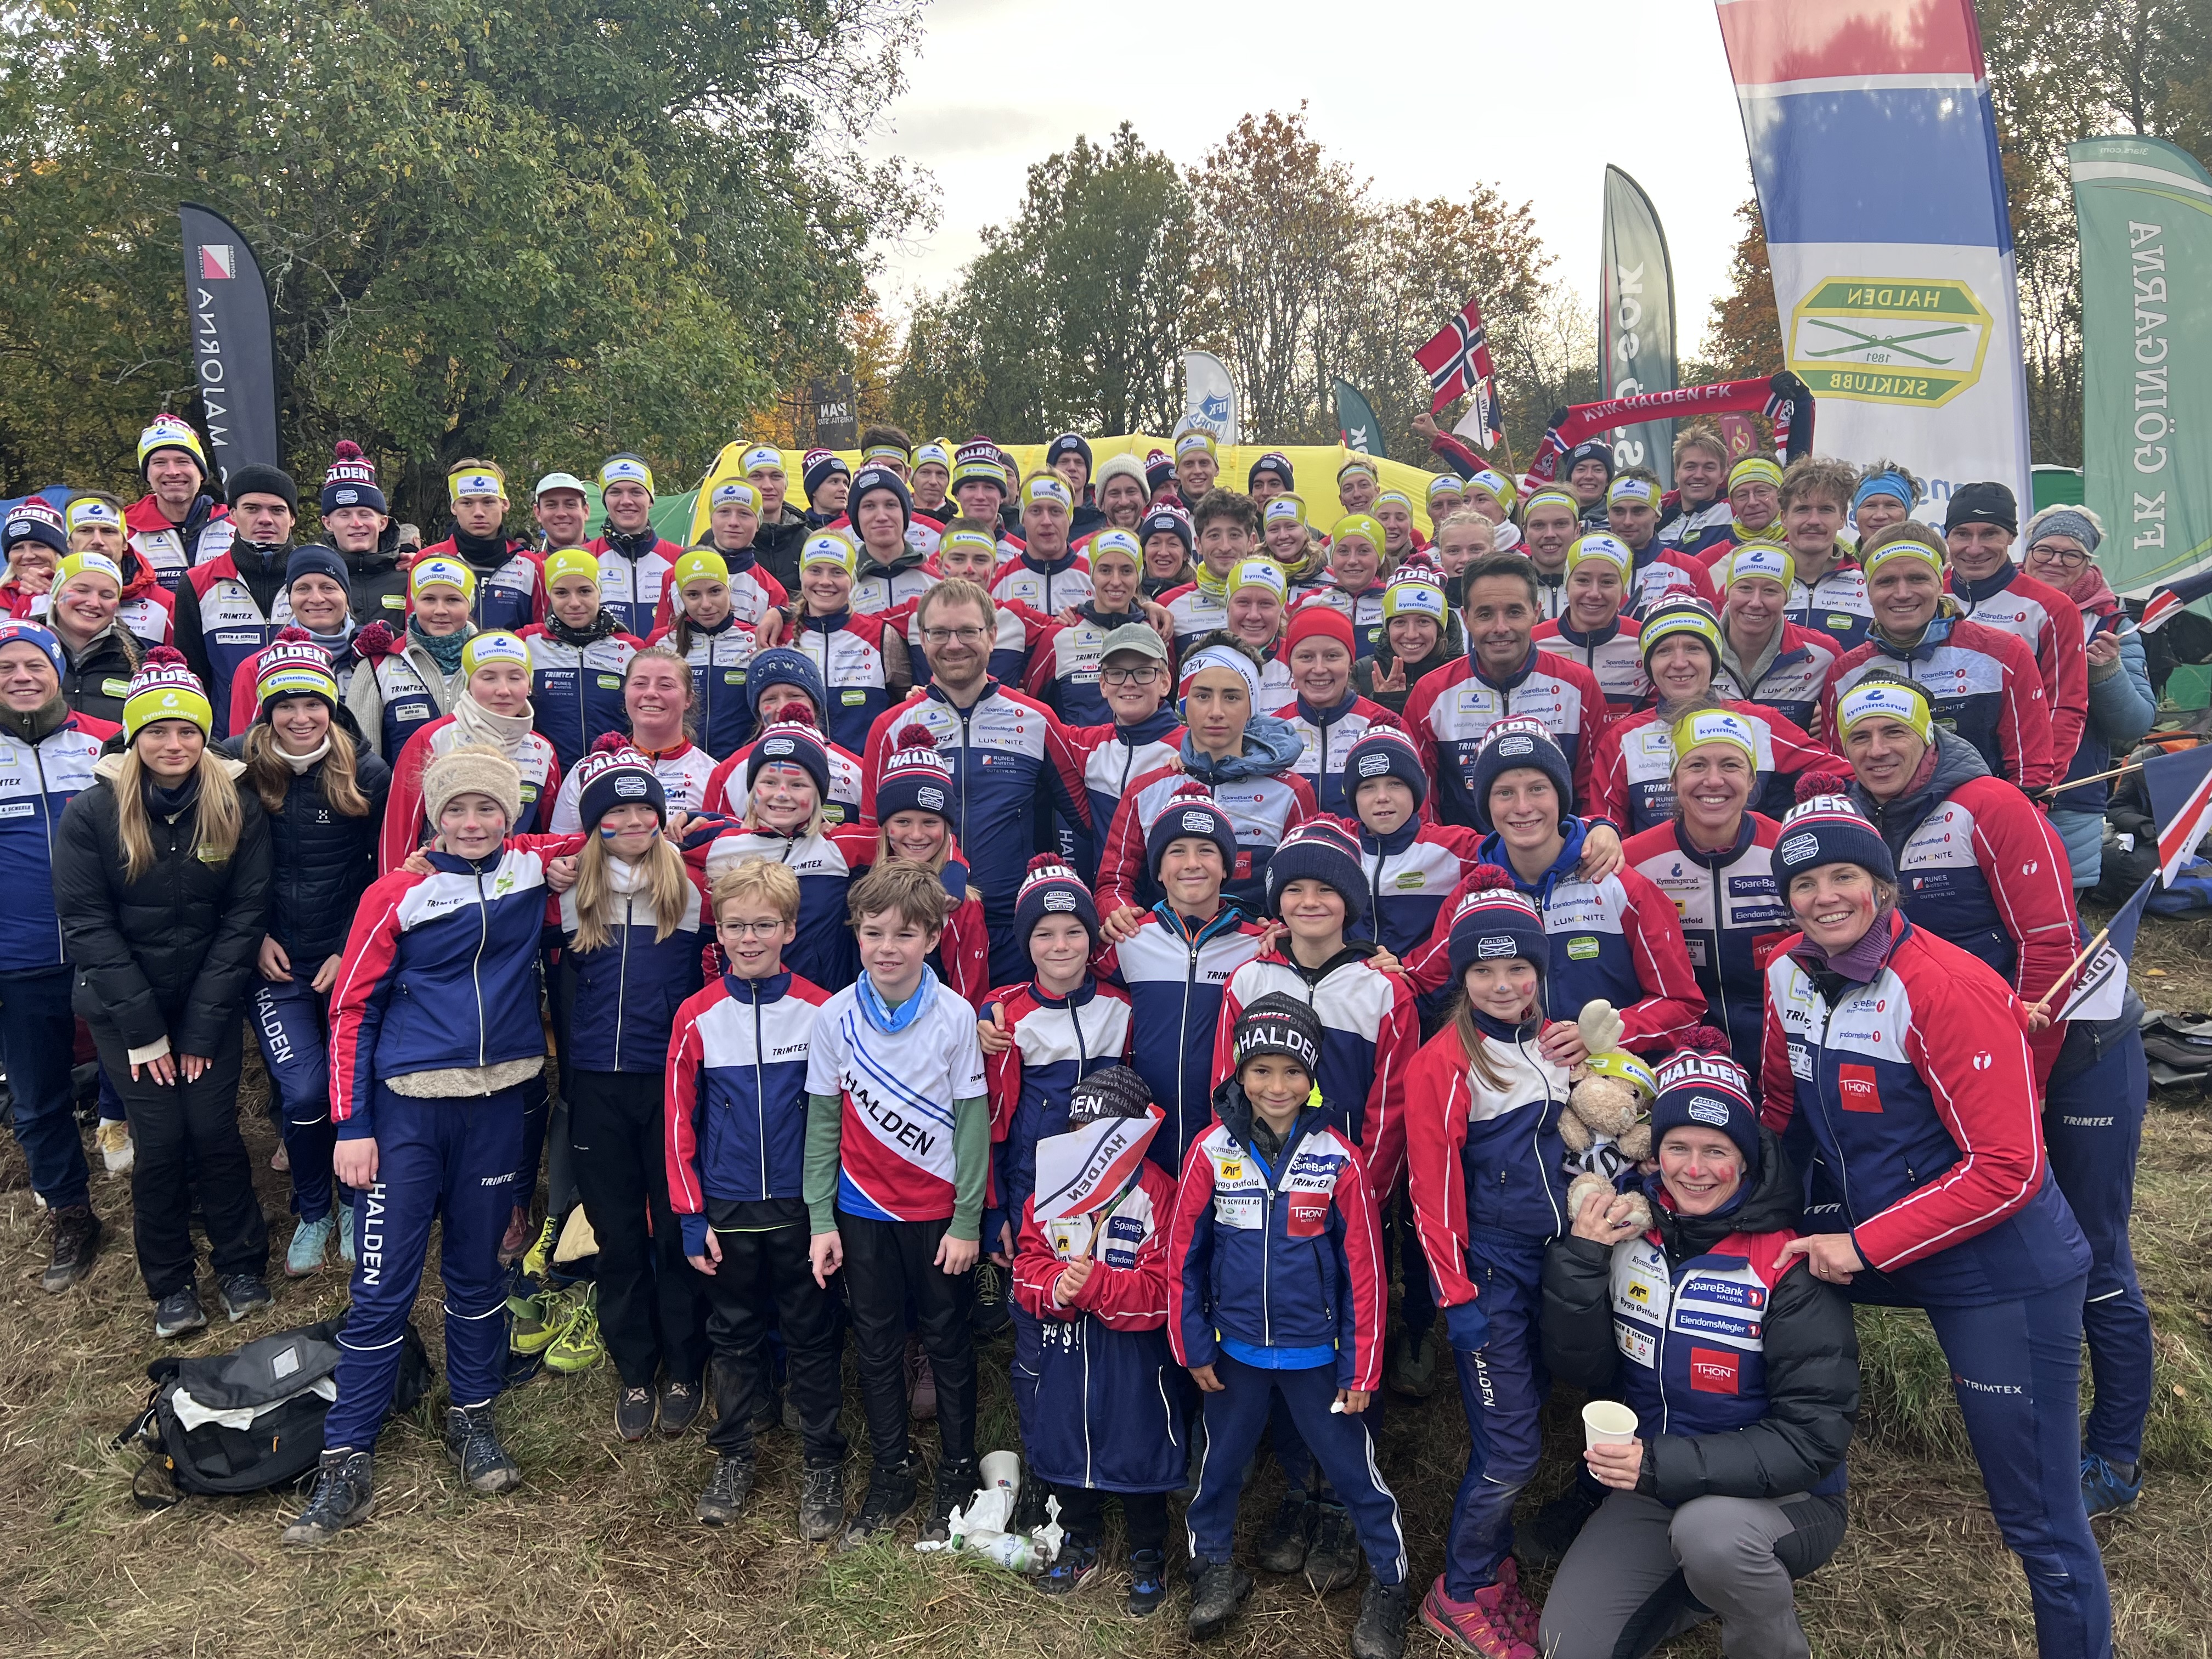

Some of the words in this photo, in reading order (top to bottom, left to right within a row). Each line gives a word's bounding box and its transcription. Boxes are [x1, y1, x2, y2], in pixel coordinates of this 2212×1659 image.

[1582, 400, 1623, 422] KVIK
[1624, 388, 1700, 409] HALDEN
[1705, 385, 1731, 399] FK
[1584, 547, 1624, 563] kynningsrud
[1882, 544, 1931, 556] kynningsrud
[1735, 563, 1780, 574] kynningsrud
[1399, 602, 1440, 612] kynningsrud
[1977, 610, 2013, 619] SpareBank
[1650, 619, 1702, 635] kynningsrud
[477, 648, 524, 658] kynningsrud
[278, 675, 324, 685] kynningsrud
[391, 685, 423, 693] TRIMTEX
[142, 709, 198, 721] kynningsrud
[1847, 702, 1907, 718] kynningsrud
[978, 737, 1024, 746] LUMONITE
[1700, 727, 1751, 746] kynningsrud
[1785, 835, 1808, 847] HALDEN
[1788, 851, 1814, 862] SKIKLUBB
[1908, 851, 1953, 864] LUMONITE
[1734, 879, 1775, 889] SpareBa
[1553, 899, 1594, 909] EiendomsMegler
[1554, 915, 1605, 927] LUMONITE
[1207, 970, 1232, 979] TRIM
[2076, 949, 2117, 991] LDEN
[255, 988, 294, 1063] HALDEN
[772, 1043, 808, 1056] TRIMTEX
[1239, 1027, 1318, 1070] HALDEN
[1659, 1062, 1746, 1089] HALDEN
[1840, 1079, 1874, 1093] THON
[1698, 1098, 1723, 1108] HALDEN
[845, 1071, 935, 1156] HALDEN
[1694, 1113, 1724, 1124] SKIKLUBB
[2063, 1115, 2113, 1126] TRIMTEX
[1232, 1179, 1259, 1189] Østfold
[1291, 1207, 1327, 1218] THON
[1114, 1220, 1142, 1233] SpareB
[364, 1183, 386, 1285] HALDEN
[1632, 1256, 1663, 1274] Kynningsr
[1689, 1282, 1743, 1296] SpareBank
[1717, 1295, 1742, 1304] HALDEN
[1621, 1297, 1634, 1308] Bygg
[1636, 1304, 1658, 1320] Østfold
[1680, 1316, 1745, 1333] EiendomsMegler
[1632, 1331, 1654, 1345] SCHEELE
[1694, 1363, 1735, 1377] THON
[1474, 1351, 1494, 1407] HALDEN
[1963, 1379, 2022, 1394] TRIMTEX
